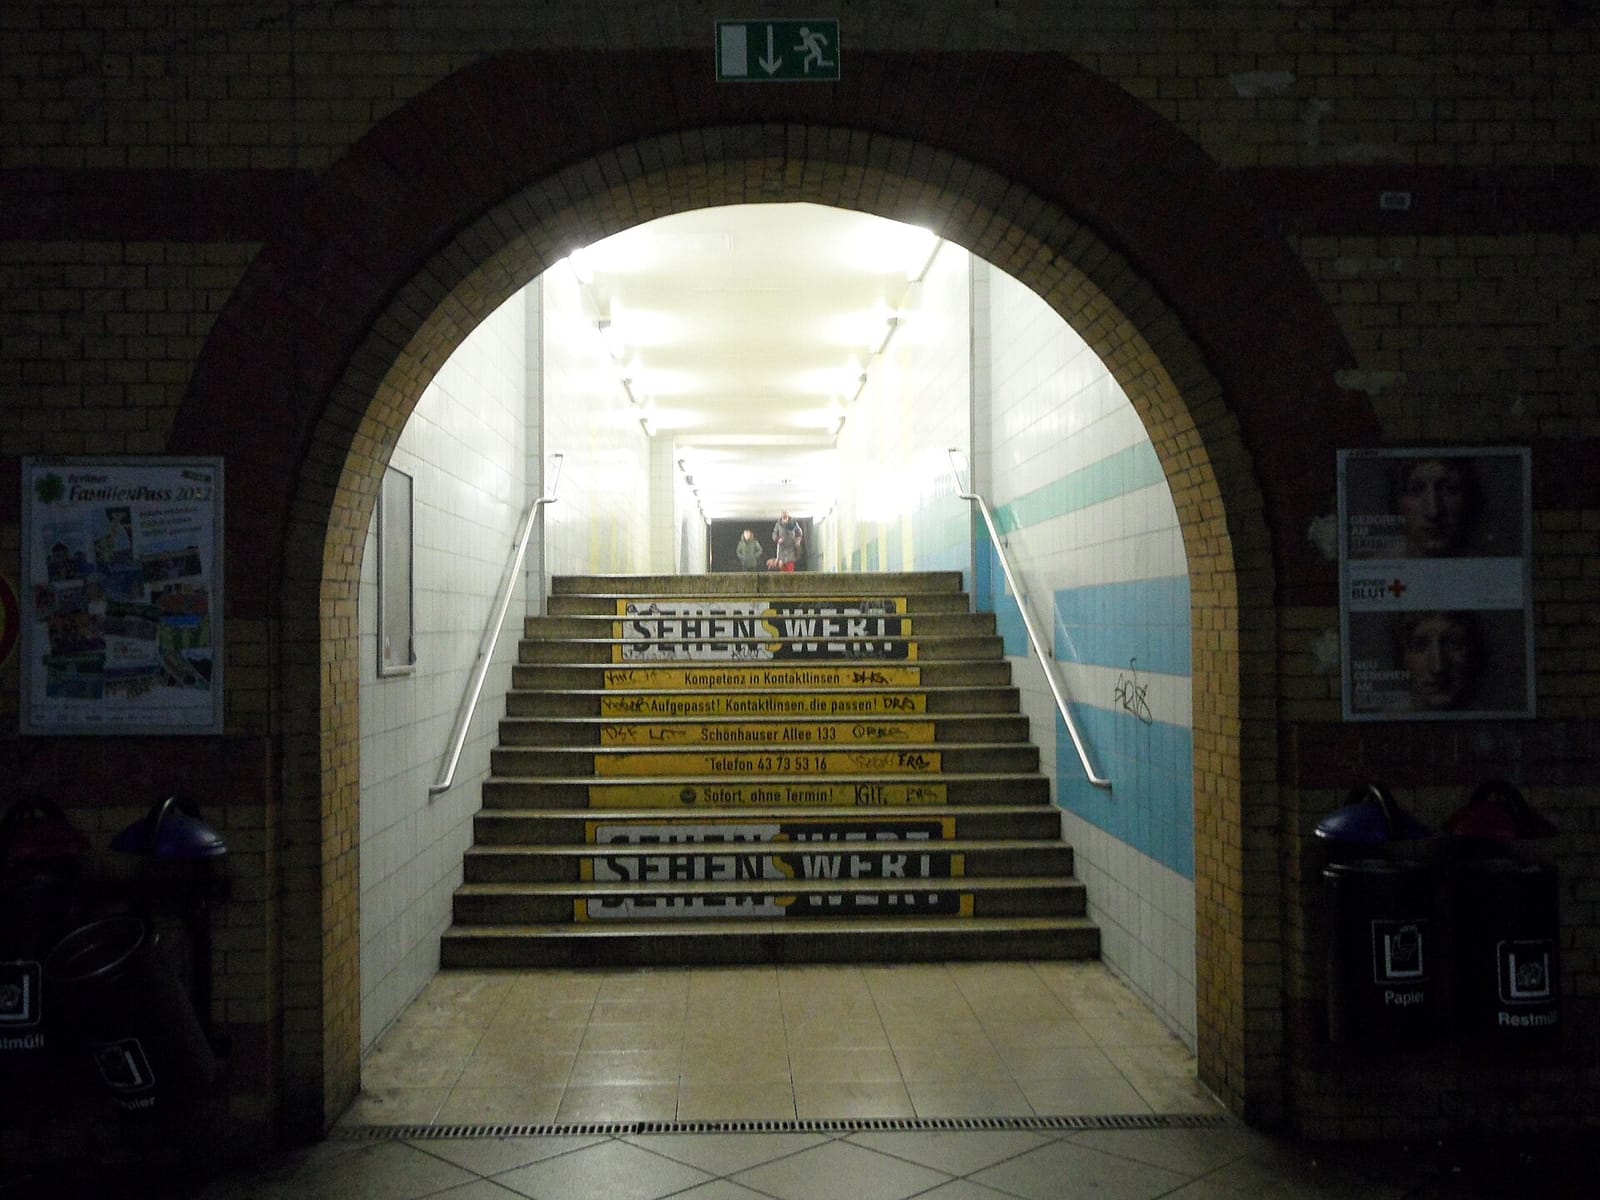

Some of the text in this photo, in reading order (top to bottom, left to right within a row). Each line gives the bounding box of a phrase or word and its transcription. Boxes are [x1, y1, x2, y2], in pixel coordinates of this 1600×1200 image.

[1352, 586, 1386, 600] BLUT
[685, 671, 746, 688] Kompetenz
[750, 672, 760, 684] in
[764, 671, 840, 684] Kontaktlinsen
[651, 698, 721, 716] Aufgepasst!
[809, 698, 827, 711] die
[831, 698, 878, 713] passen!
[701, 727, 778, 741] Schönhauser
[782, 726, 812, 741] Allee
[817, 726, 837, 741] 133
[709, 757, 827, 771] Telefon 43 73 53 16
[750, 787, 781, 802] ohne
[786, 787, 833, 802] Termin!
[1384, 990, 1425, 1007] Papier
